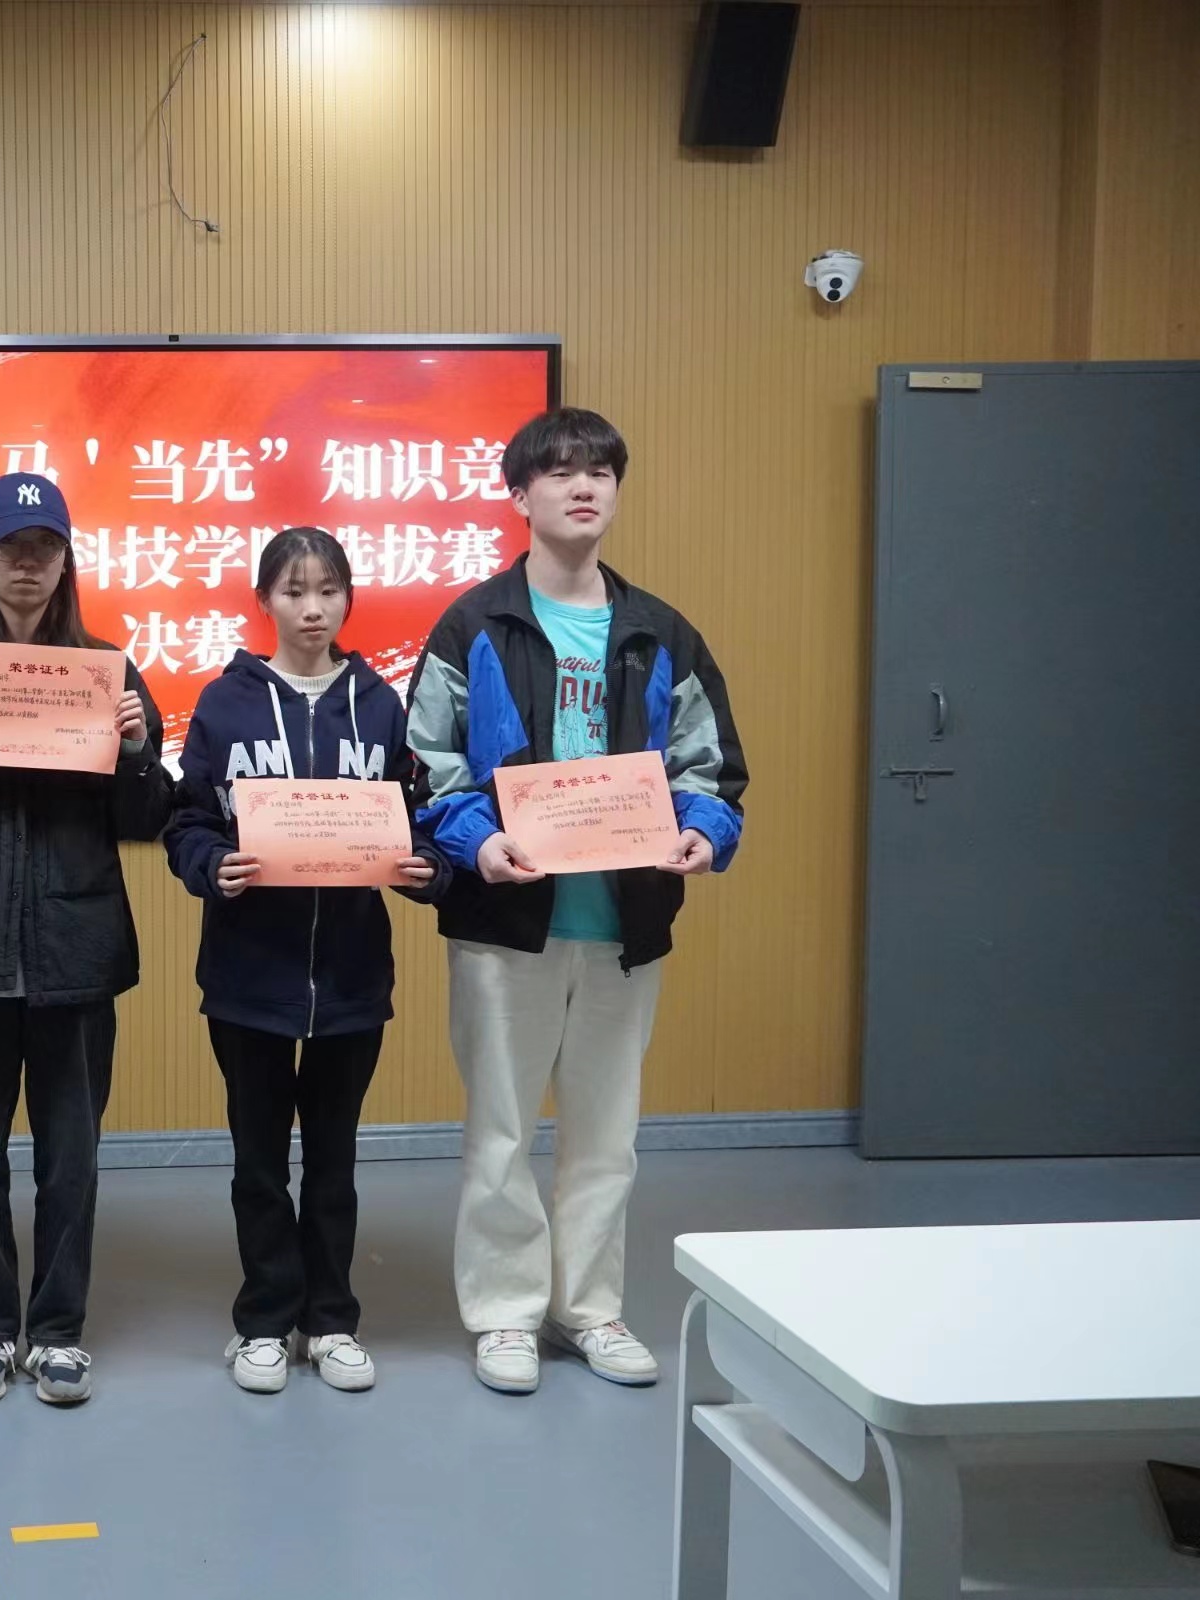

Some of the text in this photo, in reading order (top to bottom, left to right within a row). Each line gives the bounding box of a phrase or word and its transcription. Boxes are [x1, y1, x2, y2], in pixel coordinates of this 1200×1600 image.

[17, 483, 42, 506] NY
[122, 609, 249, 675] 决赛
[8, 662, 70, 676] 荣誉证书
[552, 774, 612, 789] 荣誉证书
[291, 792, 350, 801] 荣誉证书
